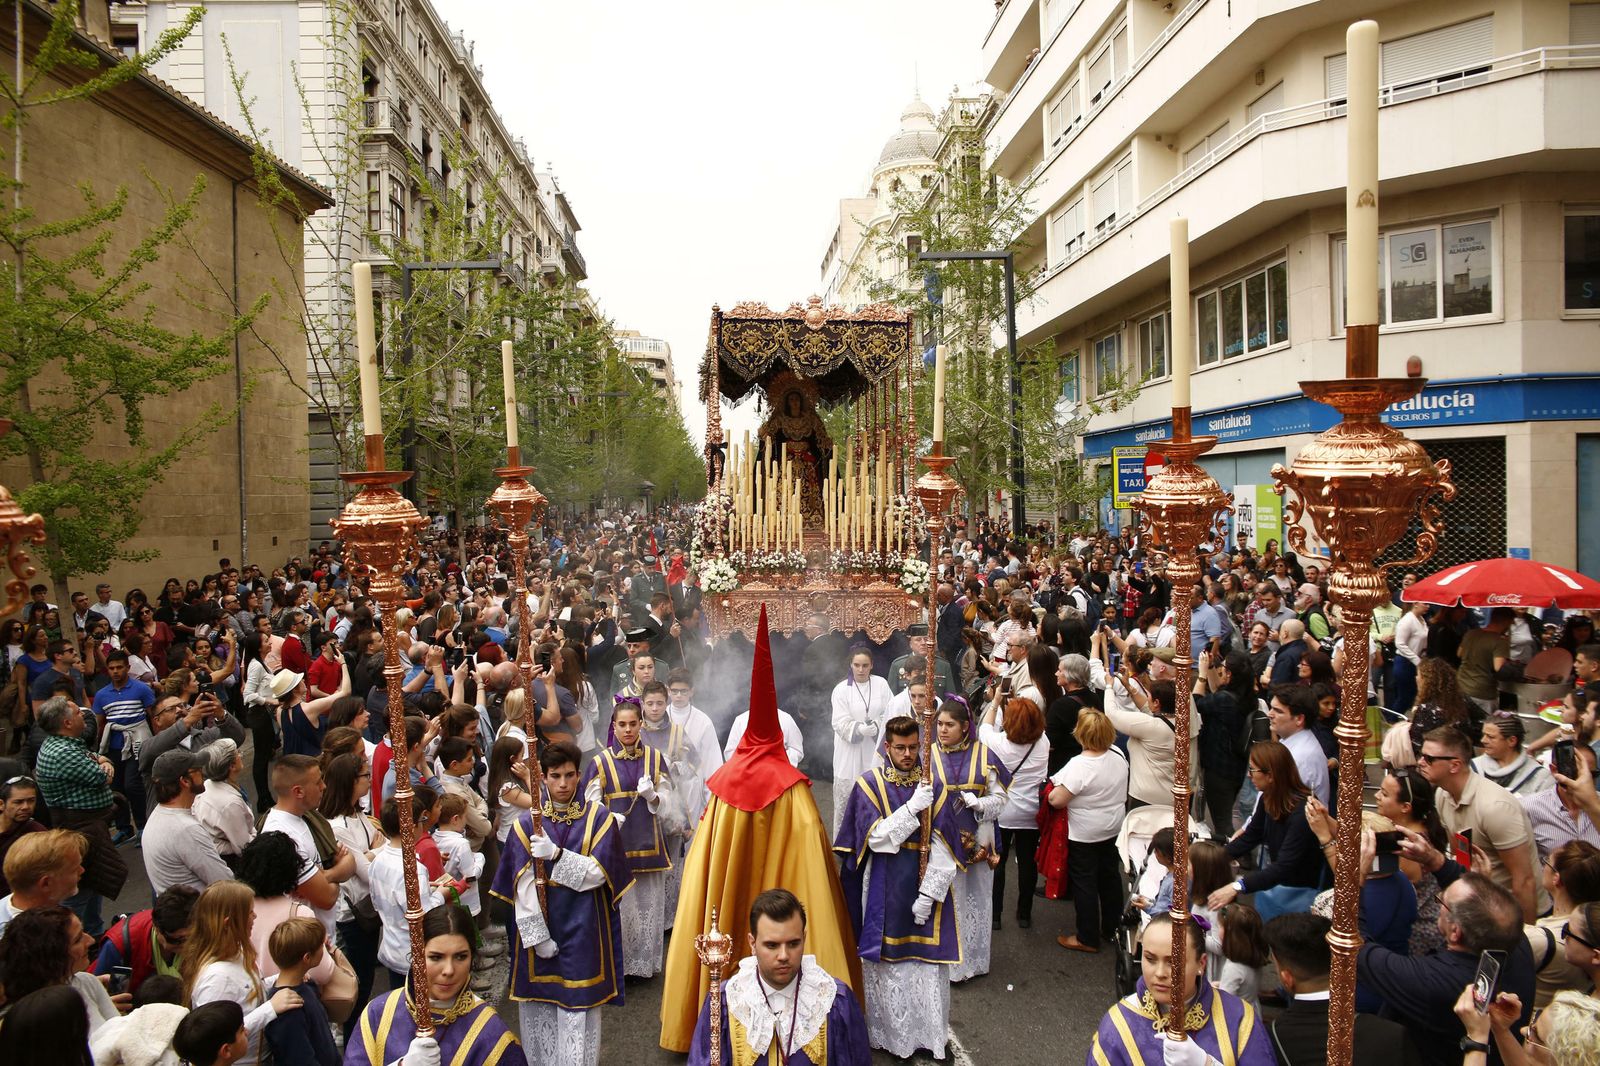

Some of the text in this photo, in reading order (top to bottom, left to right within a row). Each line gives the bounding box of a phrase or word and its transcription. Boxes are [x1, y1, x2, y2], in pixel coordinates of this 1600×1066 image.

[1391, 412, 1431, 422] SEGUROS
[1123, 478, 1144, 487] TAXI
[1238, 508, 1252, 522] PRO
